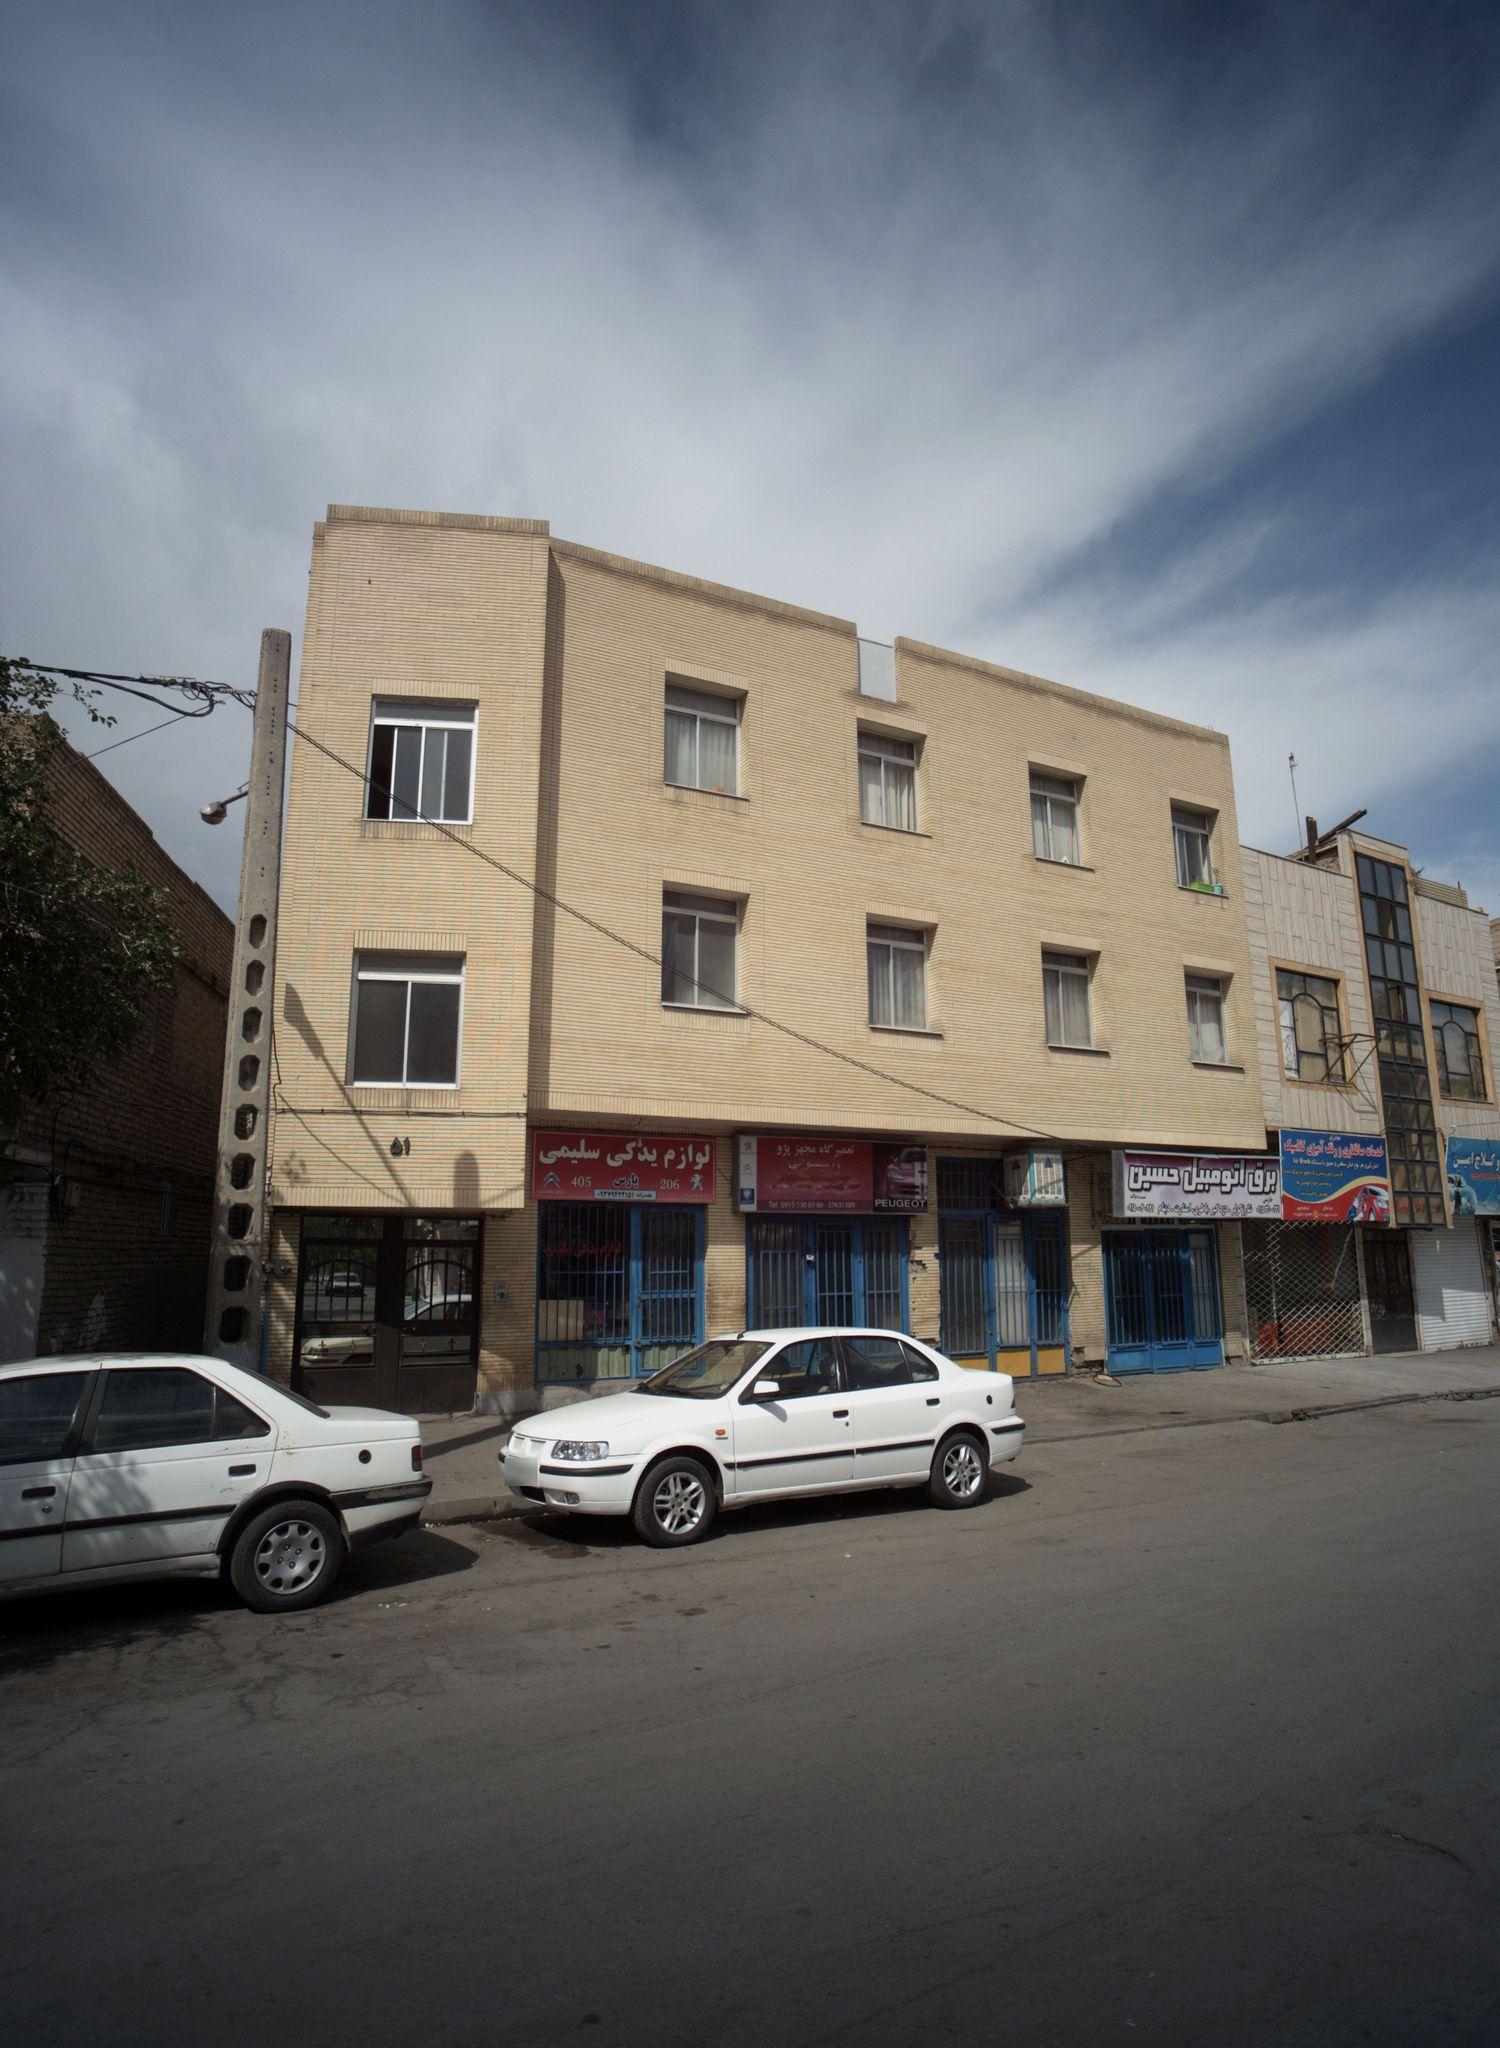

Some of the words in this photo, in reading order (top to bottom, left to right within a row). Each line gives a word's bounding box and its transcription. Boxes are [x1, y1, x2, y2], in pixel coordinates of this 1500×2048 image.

[390, 1136, 411, 1157] ۵۱
[539, 1138, 600, 1164] سلیمی
[606, 1137, 658, 1168] یدکی
[776, 1144, 791, 1157] پژو
[1284, 1139, 1306, 1154] کلاسیک
[1343, 1143, 1365, 1159] صافکاری
[1366, 1144, 1384, 1157] خدمات
[663, 1143, 711, 1170] لوازم
[1474, 1152, 1495, 1169] کلاج
[570, 1176, 592, 1188] 405
[613, 1172, 640, 1189] پارس
[1128, 1164, 1181, 1191] حسین
[1183, 1158, 1246, 1194] اتومبیل
[1248, 1161, 1278, 1194] برق
[659, 1179, 680, 1191] 206
[875, 1198, 926, 1209] PEUGEOT
